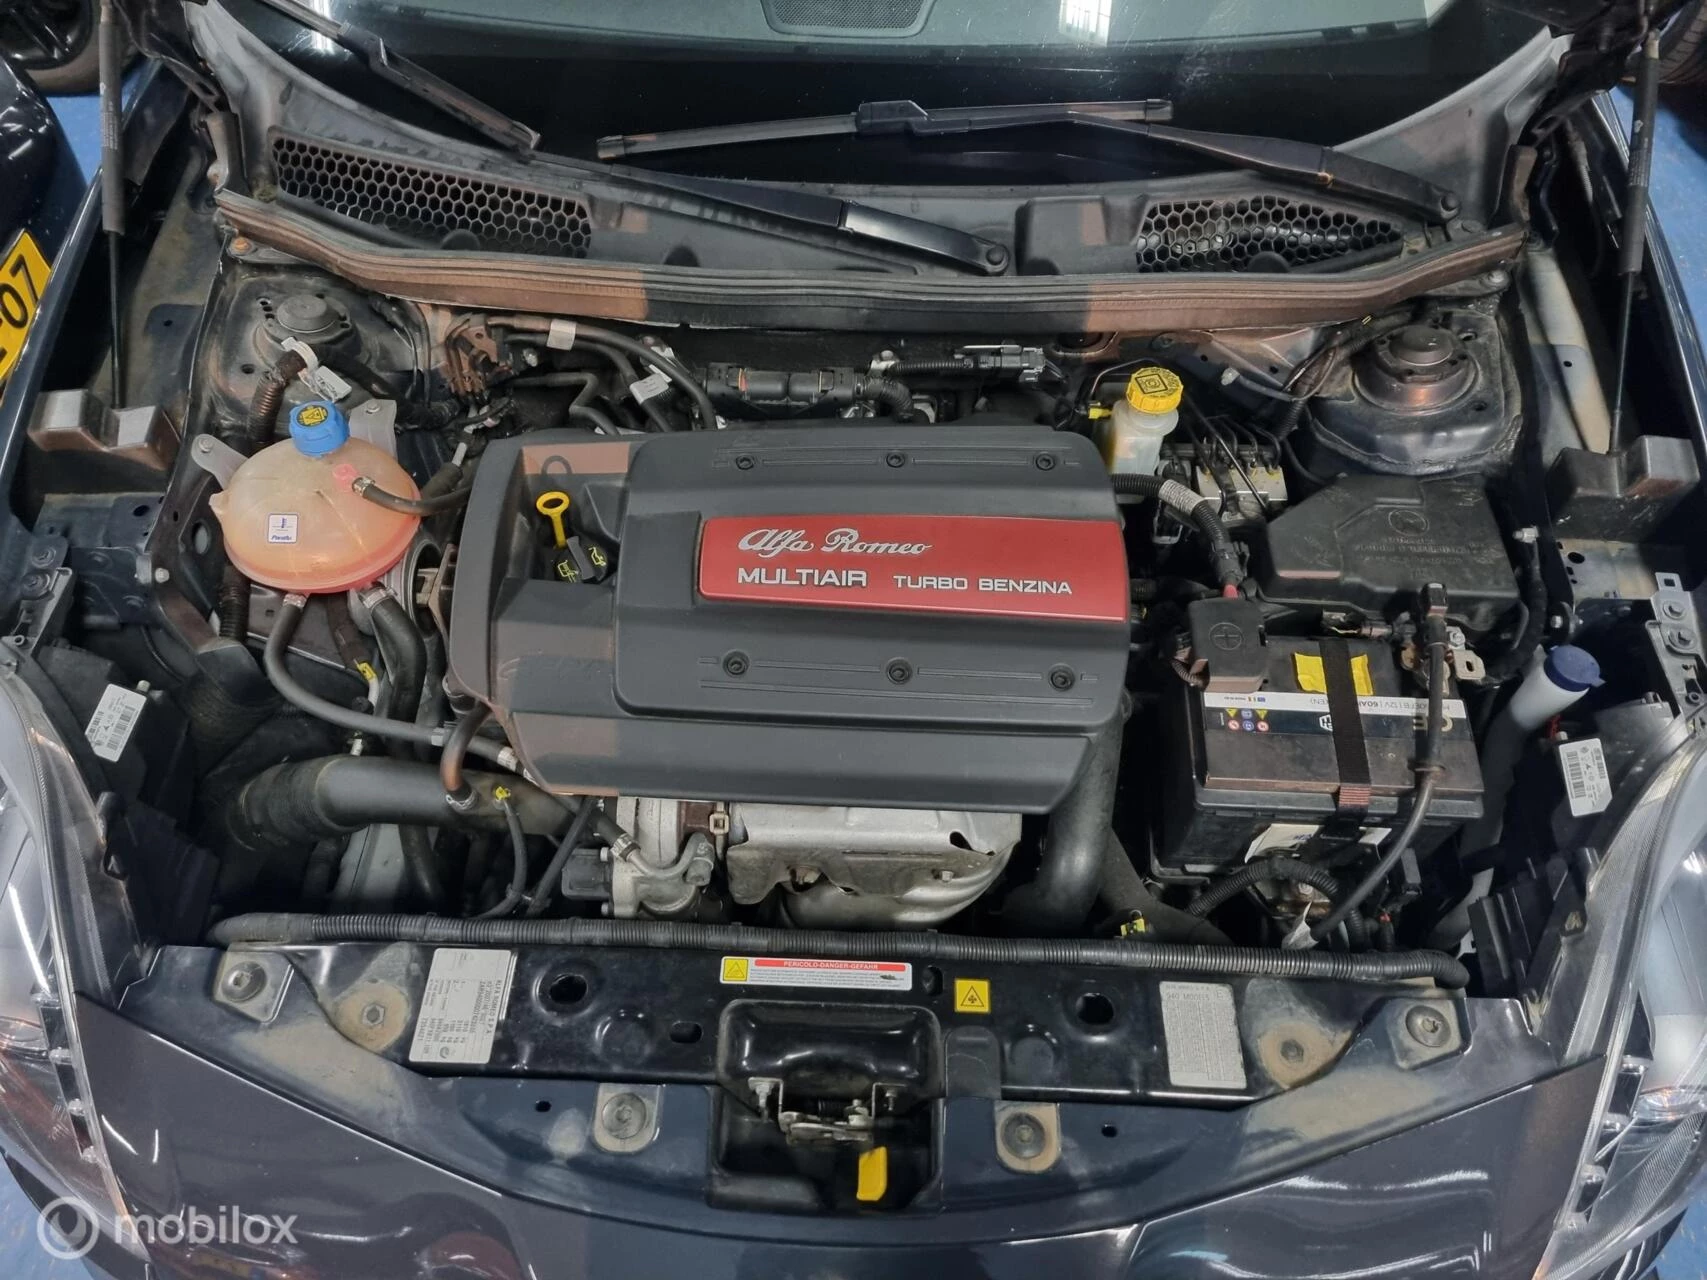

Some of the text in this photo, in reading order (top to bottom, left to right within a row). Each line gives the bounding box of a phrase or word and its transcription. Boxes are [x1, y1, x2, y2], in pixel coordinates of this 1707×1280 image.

[738, 528, 931, 558] Alfa Romeo
[738, 568, 1072, 595] MULTIAIR TURBO BENZINA
